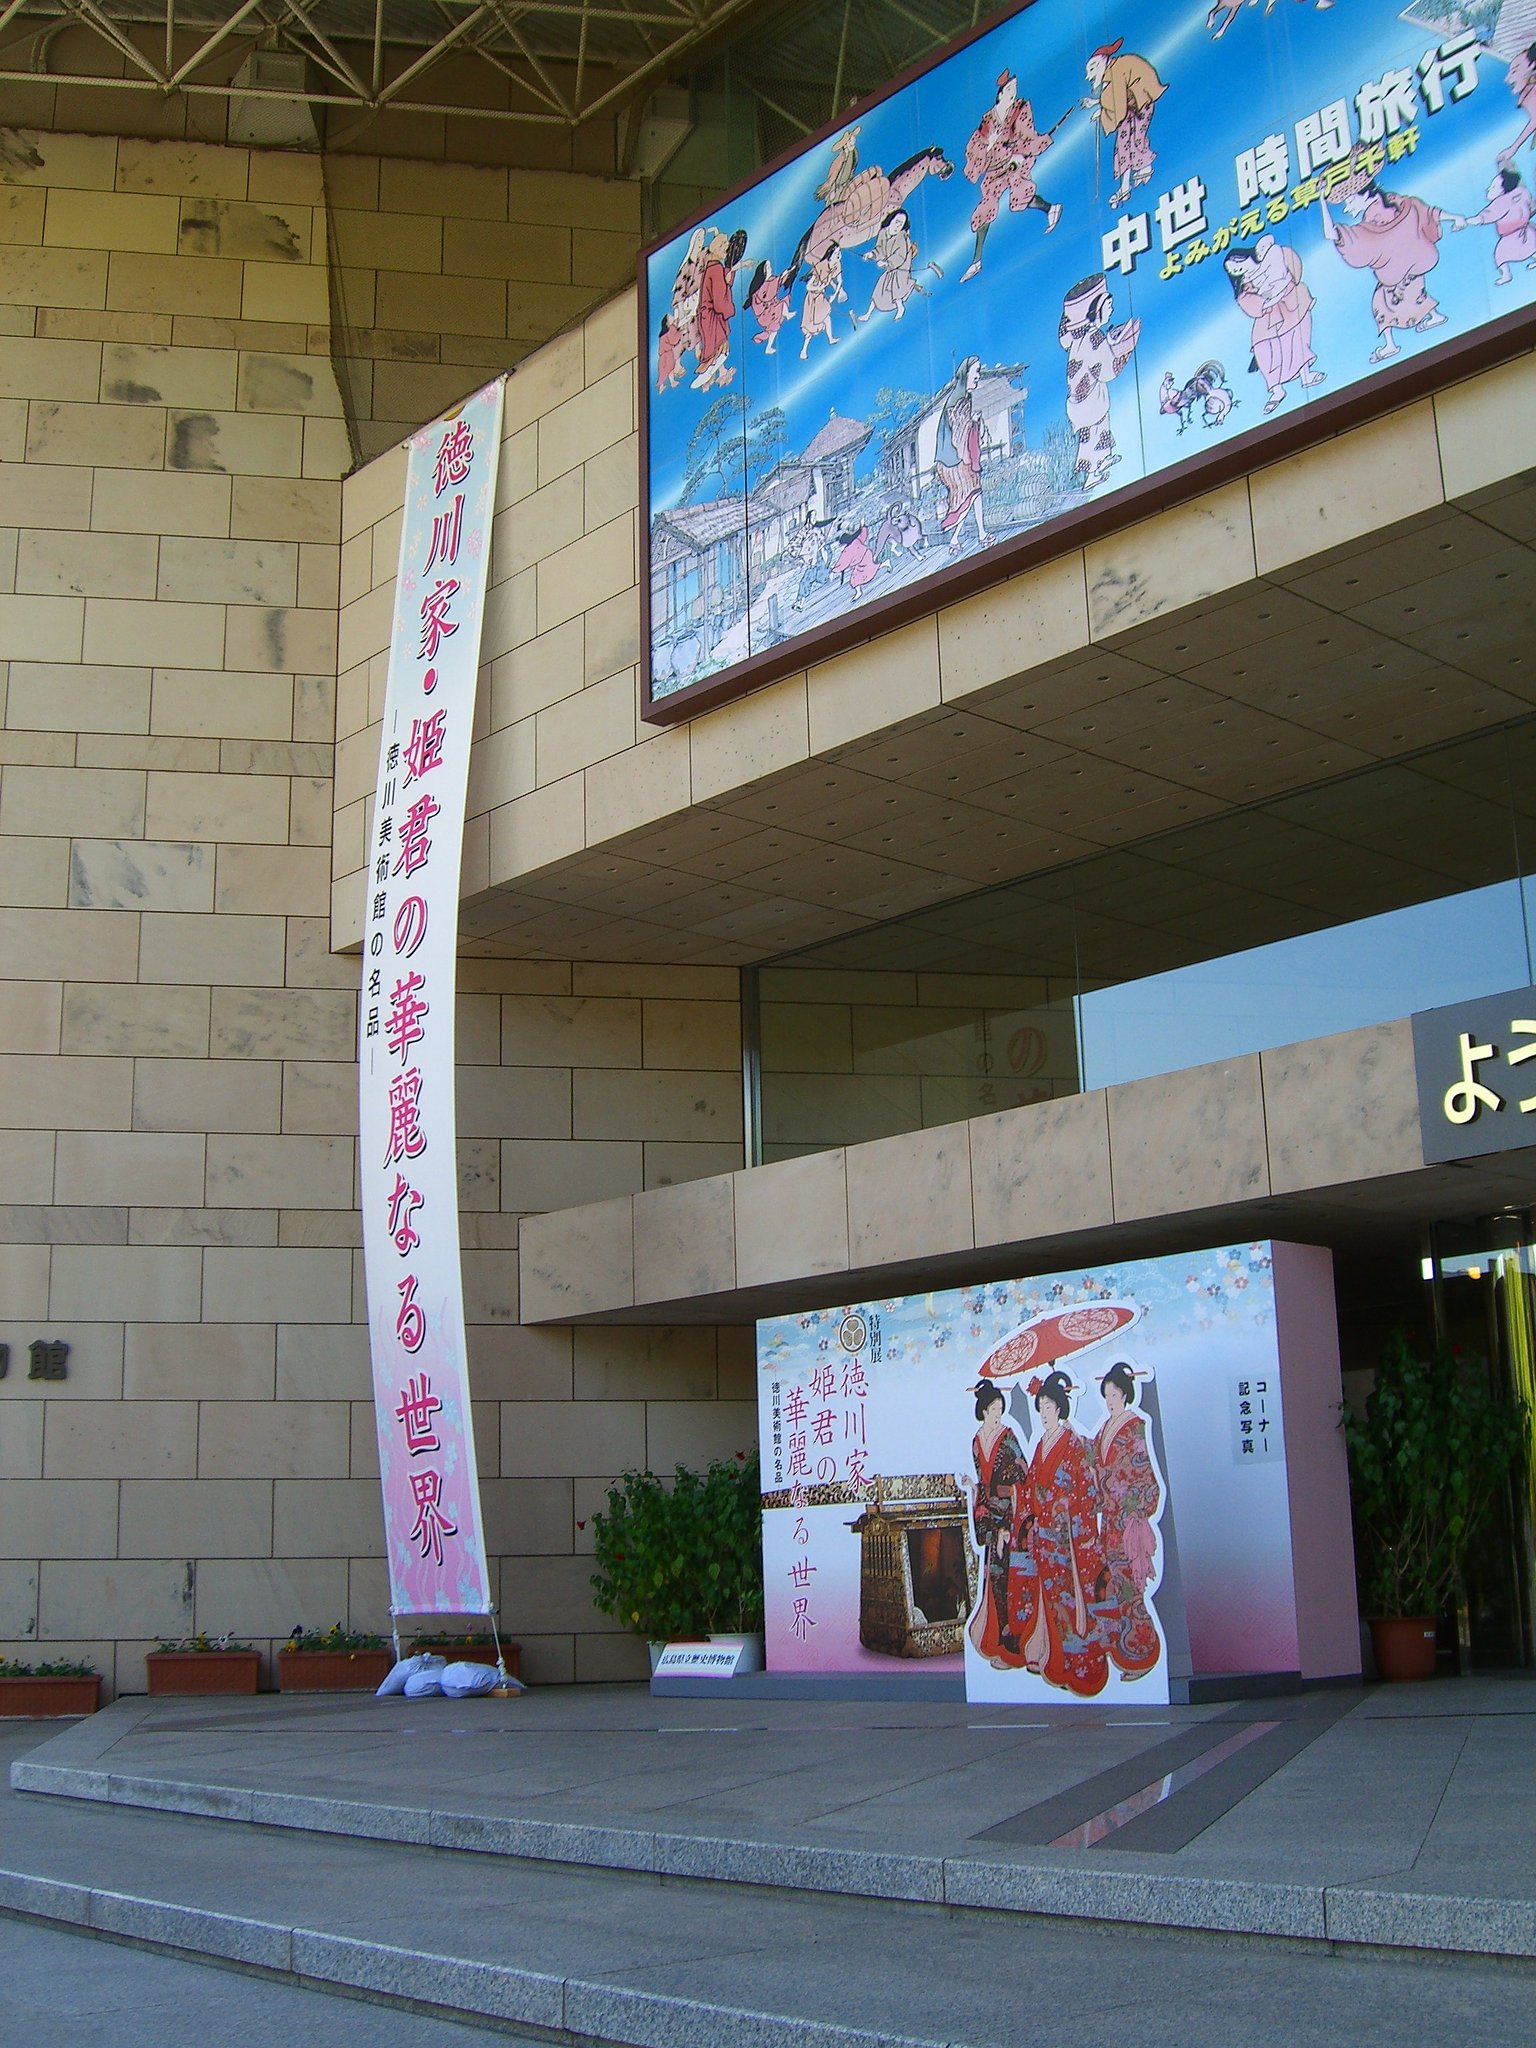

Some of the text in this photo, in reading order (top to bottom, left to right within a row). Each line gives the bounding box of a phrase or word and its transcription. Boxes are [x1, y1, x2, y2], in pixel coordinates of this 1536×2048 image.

[1102, 27, 1486, 275] 中世 時間旅行
[1159, 125, 1421, 281] よみがえる草戸千軒
[869, 1313, 882, 1364] 特別展
[808, 1363, 838, 1484] 姫君の
[840, 1361, 874, 1495] 徳川家
[1238, 1381, 1255, 1454] 記念写真
[1256, 1381, 1270, 1452] コーナー
[782, 1385, 818, 1641] 華麗なる世界
